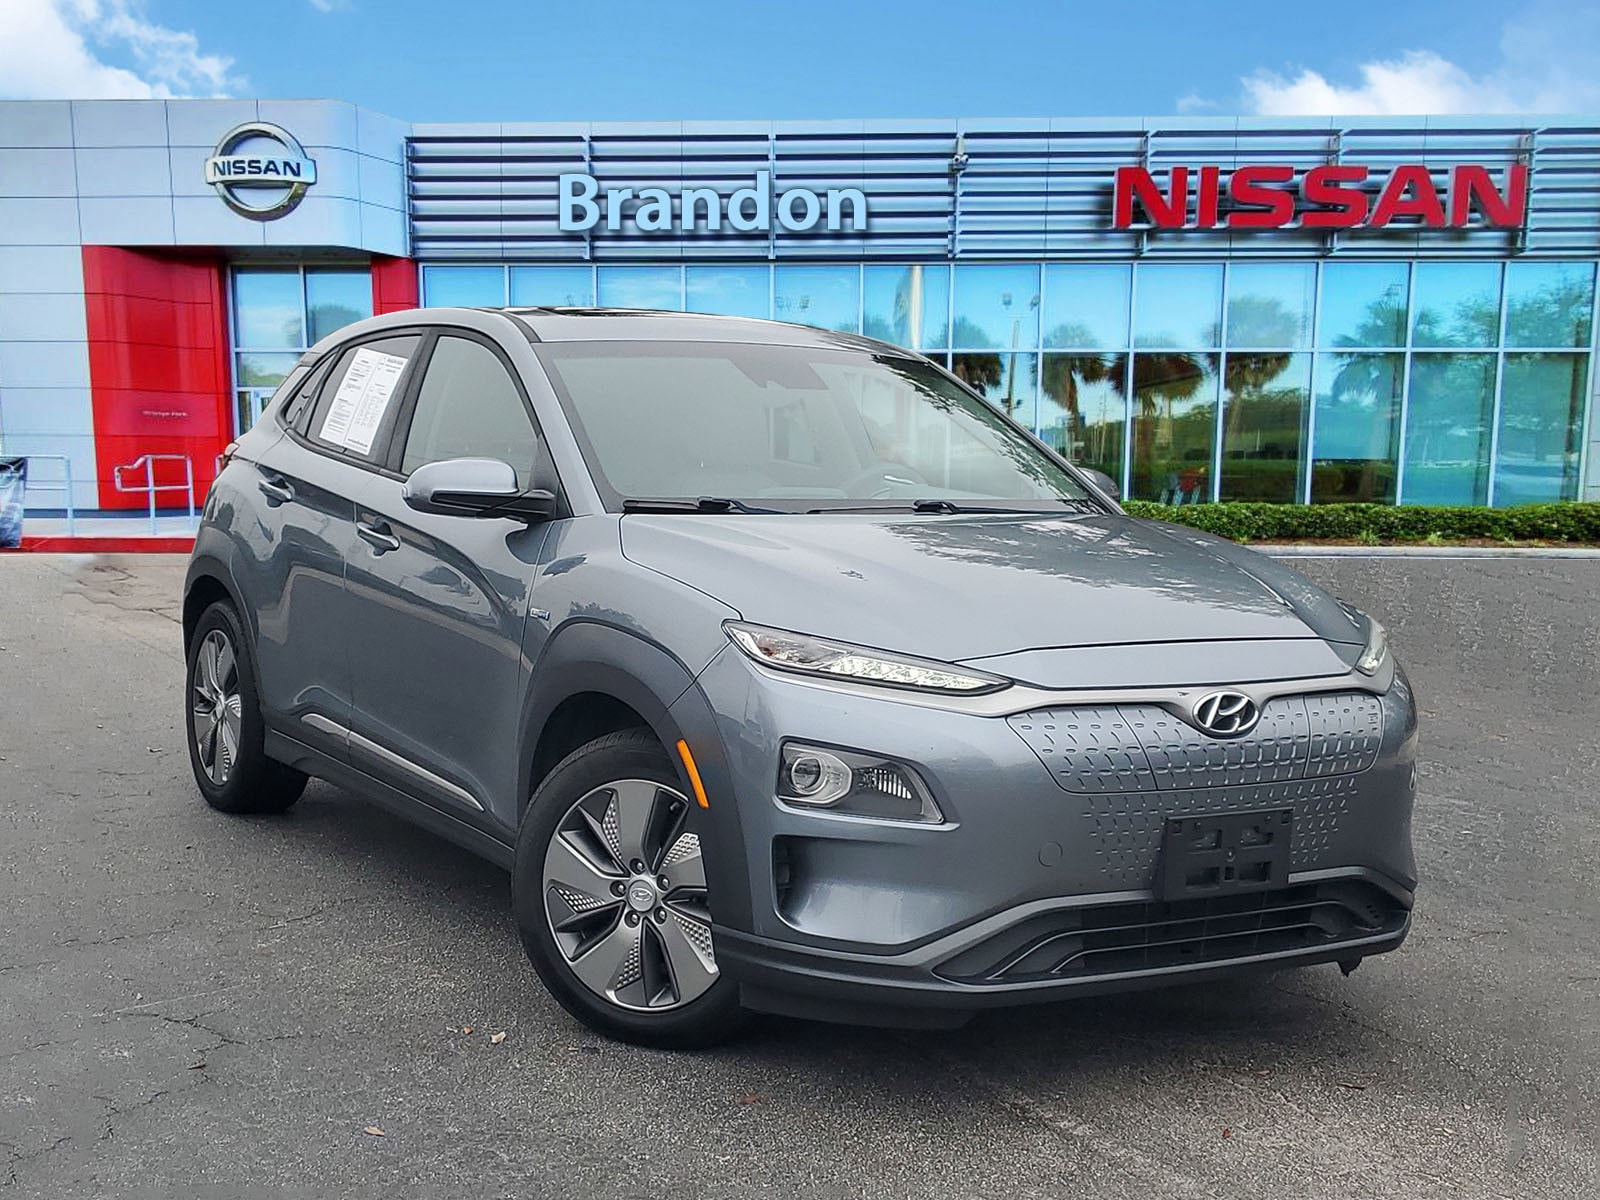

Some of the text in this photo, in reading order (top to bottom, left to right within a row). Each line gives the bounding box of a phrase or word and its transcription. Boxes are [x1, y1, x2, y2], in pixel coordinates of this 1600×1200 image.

[213, 159, 301, 177] NISSAN
[1113, 164, 1528, 229] NISSAN
[559, 171, 867, 231] Brandon
